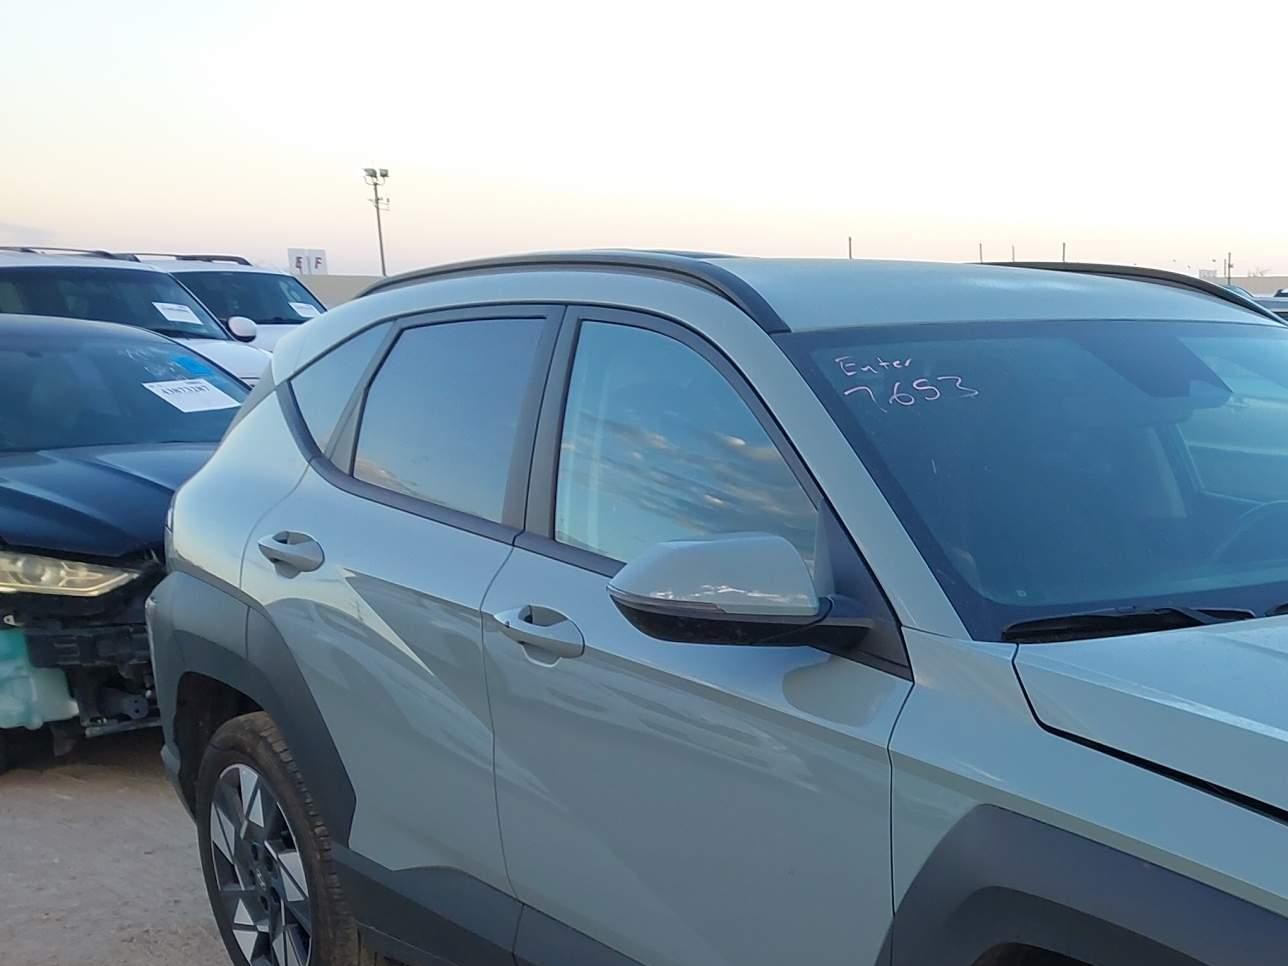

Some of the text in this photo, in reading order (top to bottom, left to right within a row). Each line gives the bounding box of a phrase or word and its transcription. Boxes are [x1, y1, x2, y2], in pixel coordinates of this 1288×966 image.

[314, 256, 323, 270] F
[835, 356, 912, 376] Enter
[843, 376, 979, 413] 7653
